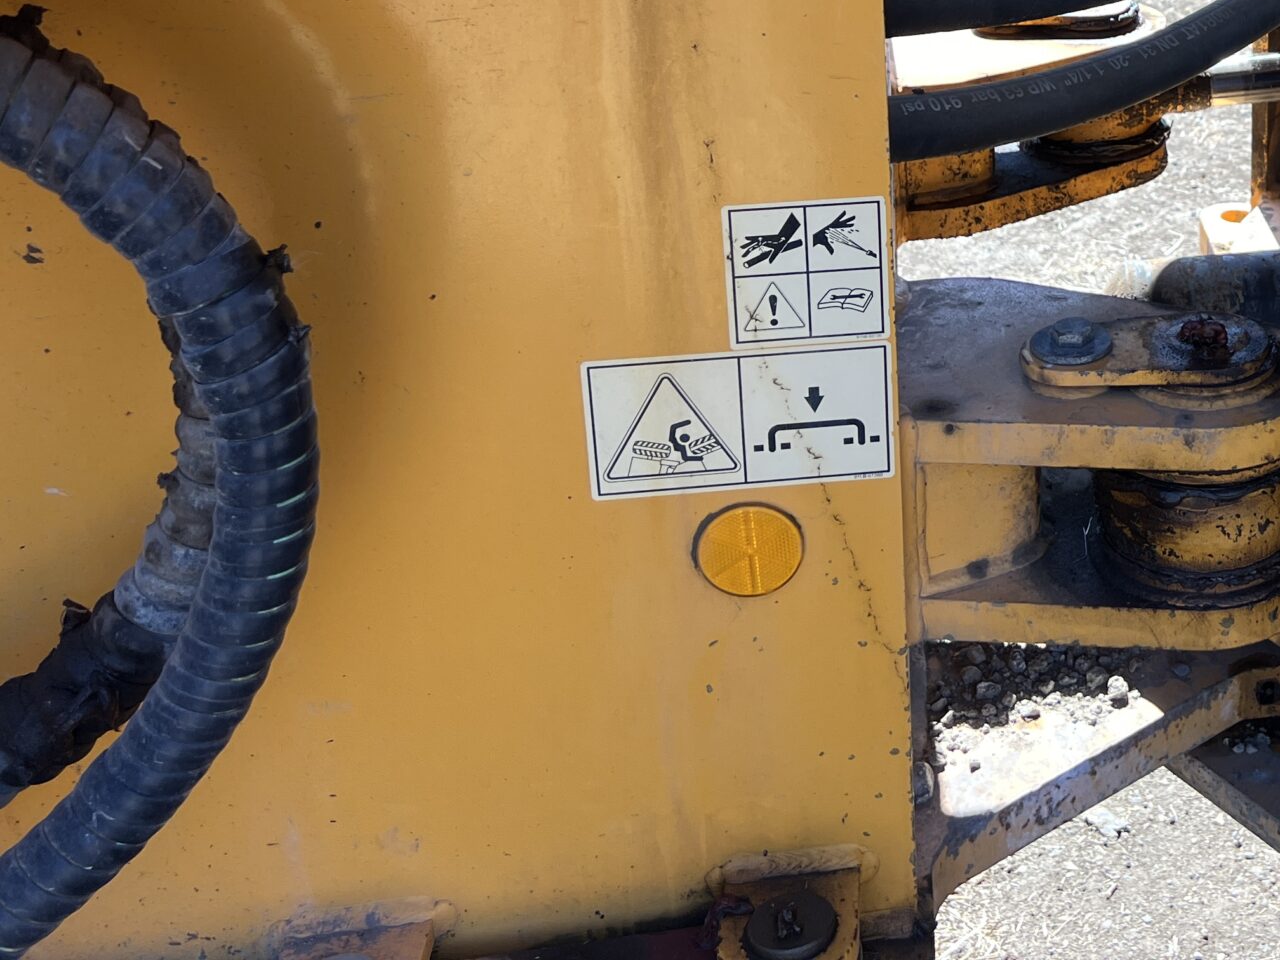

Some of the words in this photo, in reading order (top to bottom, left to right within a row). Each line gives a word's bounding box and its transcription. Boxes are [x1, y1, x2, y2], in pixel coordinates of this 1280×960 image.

[1155, 36, 1180, 53] DN
[1139, 46, 1156, 60] 31
[1110, 53, 1131, 70] -20
[1005, 86, 1024, 100] 63
[1029, 77, 1057, 95] WP
[971, 89, 1002, 103] bar
[901, 101, 926, 116] psi
[928, 97, 963, 112] 910
